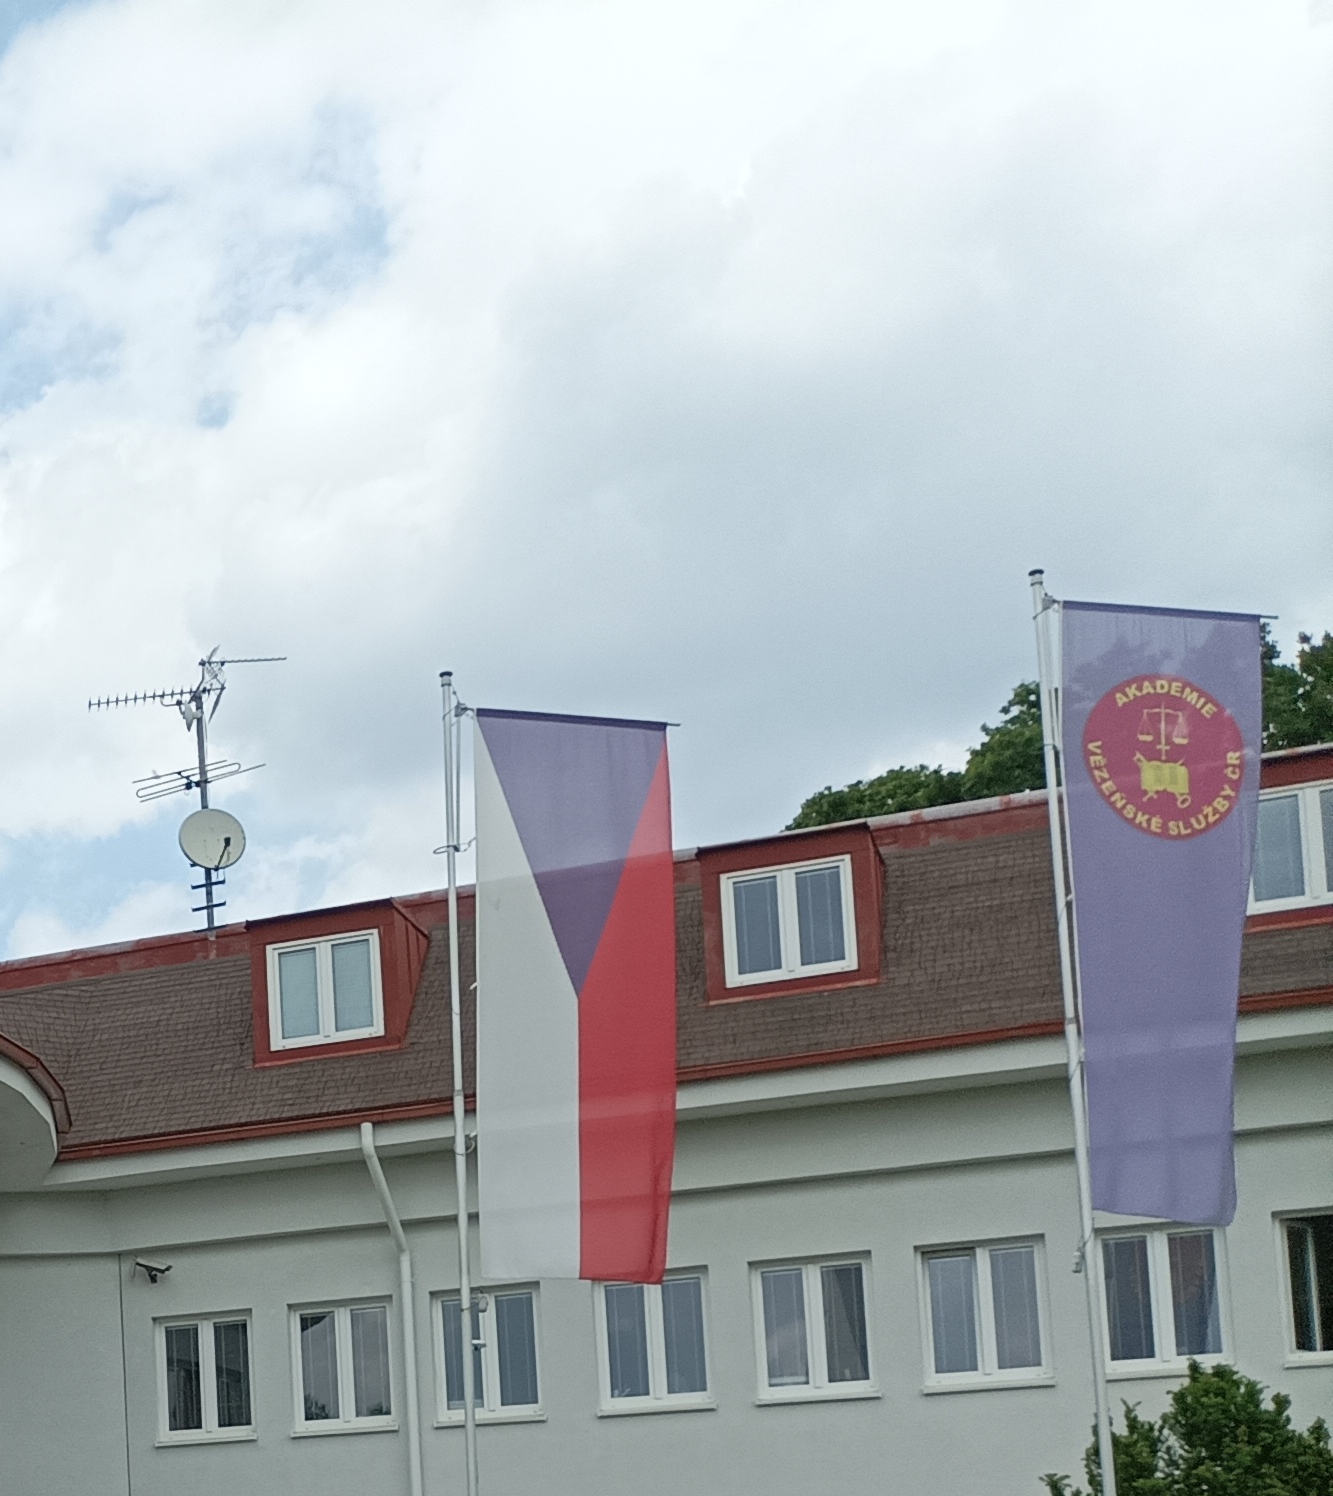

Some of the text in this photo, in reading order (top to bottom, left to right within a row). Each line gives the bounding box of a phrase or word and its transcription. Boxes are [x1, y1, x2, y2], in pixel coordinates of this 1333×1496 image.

[1115, 679, 1218, 719] AKADEMIE
[1168, 783, 1236, 835] SLUŽBY
[1223, 751, 1241, 780] ČR
